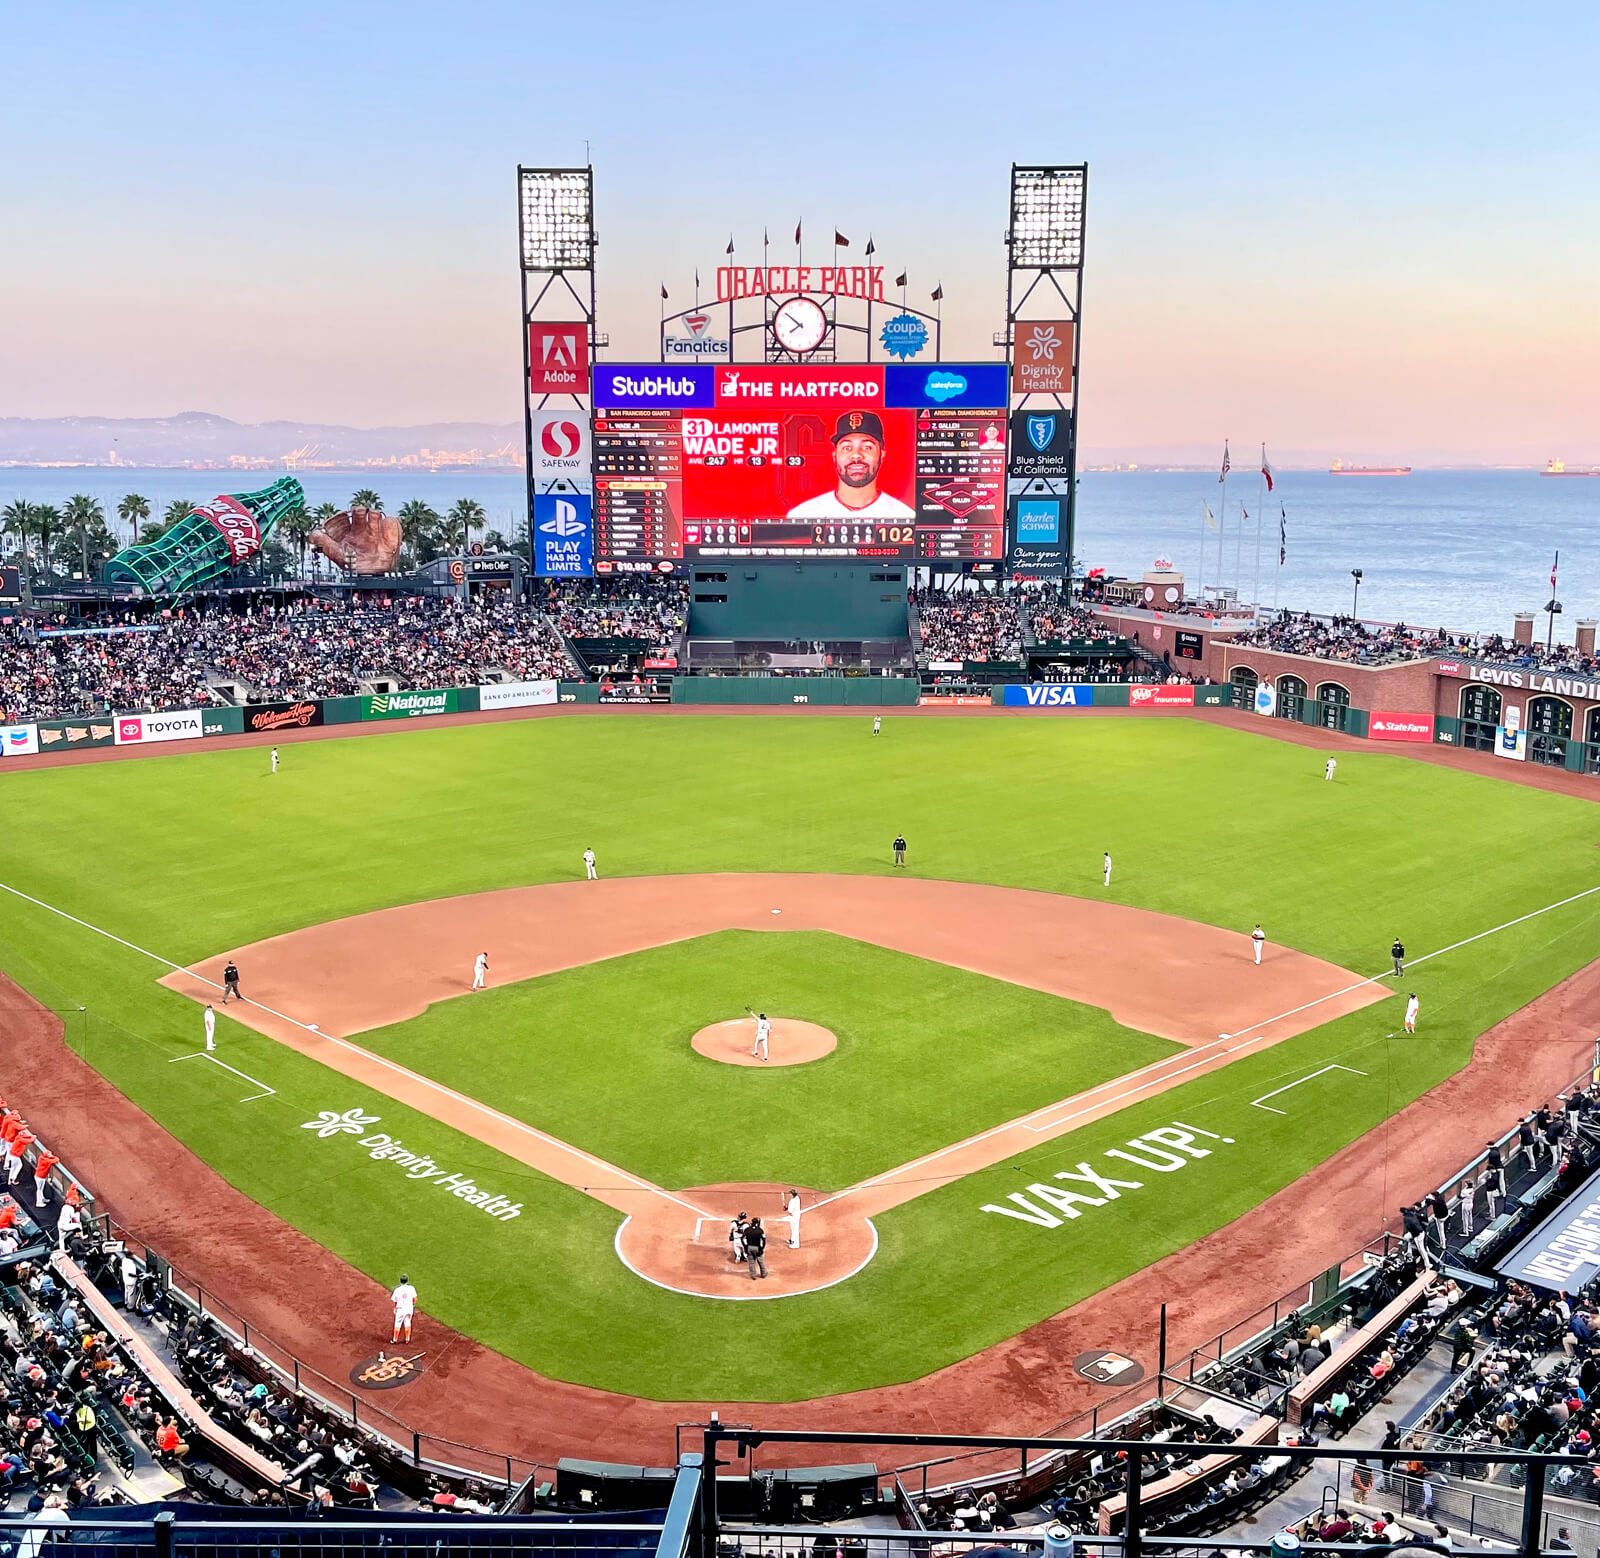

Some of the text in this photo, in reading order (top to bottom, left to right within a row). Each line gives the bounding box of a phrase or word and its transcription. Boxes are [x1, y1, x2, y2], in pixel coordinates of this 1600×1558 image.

[717, 266, 884, 303] ORACLE PARK
[886, 322, 924, 336] coupa
[665, 338, 728, 353] Fanatics
[543, 370, 576, 383] Adobe
[1021, 364, 1064, 379] Dignity
[612, 376, 695, 396] StubHub
[930, 381, 963, 390] salesforce
[1022, 379, 1062, 389] Health
[739, 382, 879, 397] THE HARTFORD
[687, 420, 706, 435] 31
[714, 422, 778, 435] LAMONTE
[684, 438, 777, 455] WADE JR
[542, 459, 581, 468] SAFEWAY
[751, 457, 762, 465] 13
[788, 457, 801, 465] 33
[1016, 456, 1064, 465] Blue Shield
[1013, 465, 1067, 474] of California
[1022, 512, 1054, 522] charles
[704, 525, 711, 534] 0
[717, 525, 724, 534] 0
[729, 525, 736, 534] 0
[741, 525, 748, 534] 0
[815, 526, 822, 534] 0
[841, 526, 848, 534] 0
[1021, 523, 1055, 531] SCHWAB
[705, 535, 711, 543] 4
[717, 535, 724, 543] 0
[729, 535, 736, 543] 0
[841, 535, 848, 543] 0
[546, 541, 581, 553] PLAY
[1037, 551, 1061, 562] your
[546, 562, 583, 571] LIMITS.
[1012, 559, 1062, 568] tomorrow
[1154, 559, 1172, 569] Coors
[1012, 572, 1039, 583] Coors
[1044, 675, 1143, 683] WELCOME TO THE 415
[1529, 674, 1600, 701] LANDI
[484, 693, 501, 701] BANK
[512, 690, 540, 699] AMERICA
[560, 694, 576, 702] 399
[793, 695, 808, 704] 391
[1020, 686, 1076, 706] VISA
[1154, 695, 1192, 704] Insurance
[388, 692, 447, 711] National
[252, 702, 316, 729] Welcome Home
[422, 707, 445, 715] Rental
[147, 719, 198, 733] TOYOTA
[204, 724, 223, 734] 354
[1439, 732, 1453, 743] 365
[357, 1133, 524, 1221] Dignity Health
[978, 1121, 1236, 1229] VAX UP!
